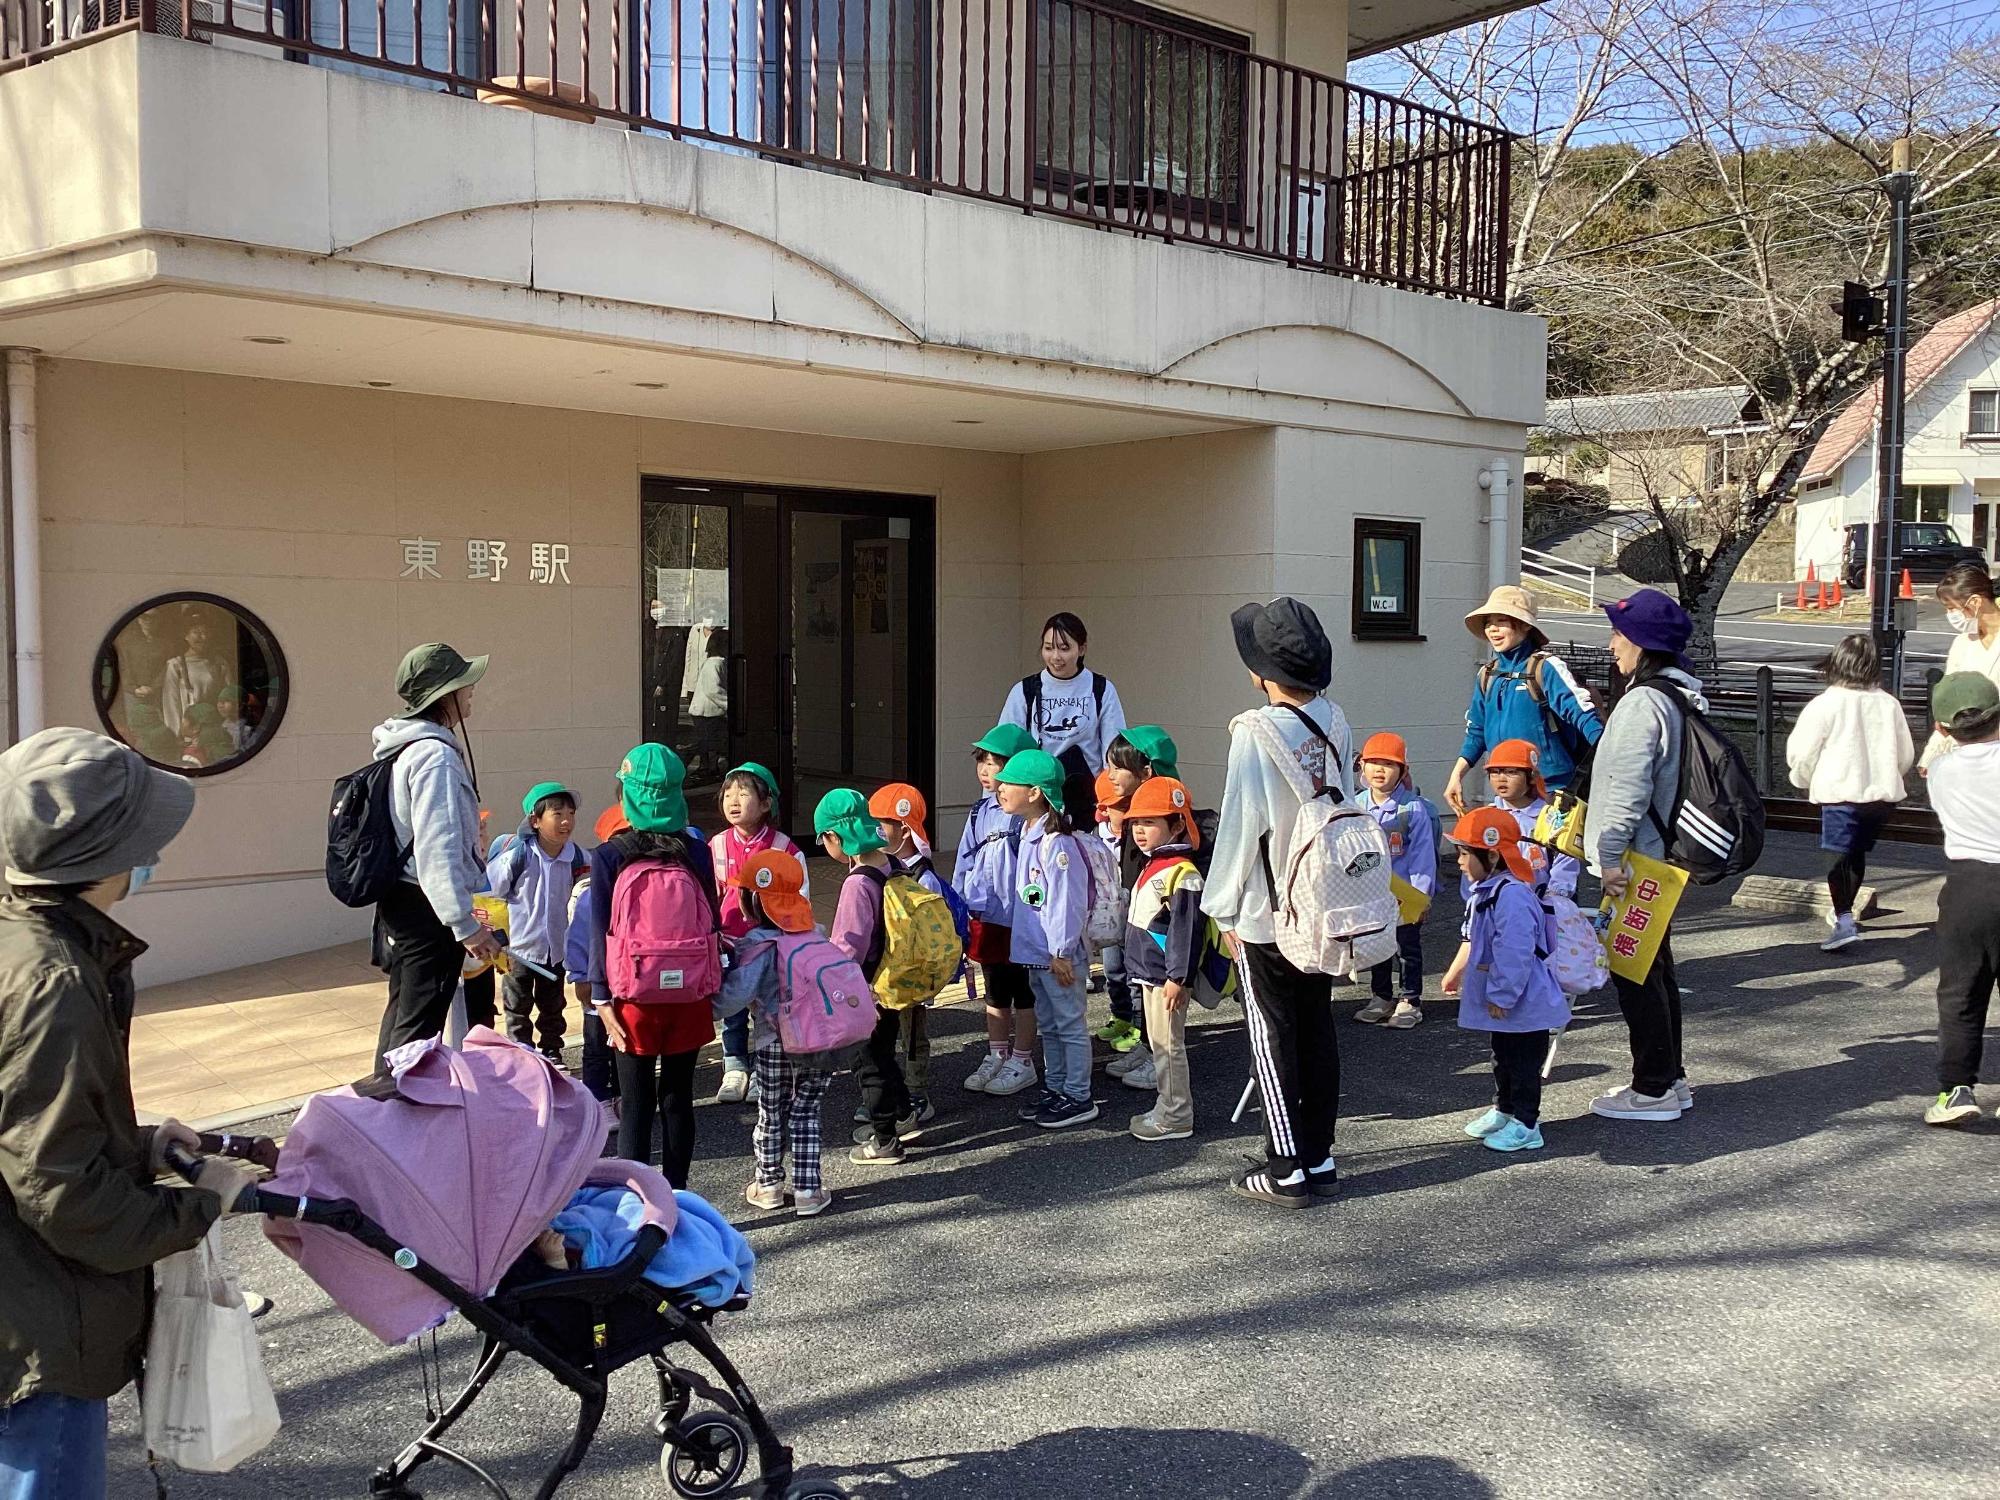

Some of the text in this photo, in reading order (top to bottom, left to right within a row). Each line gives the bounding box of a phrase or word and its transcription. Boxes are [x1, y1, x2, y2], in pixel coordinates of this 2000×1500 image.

[399, 535, 571, 584] 東野駅
[1612, 878, 1662, 958] 横断中
